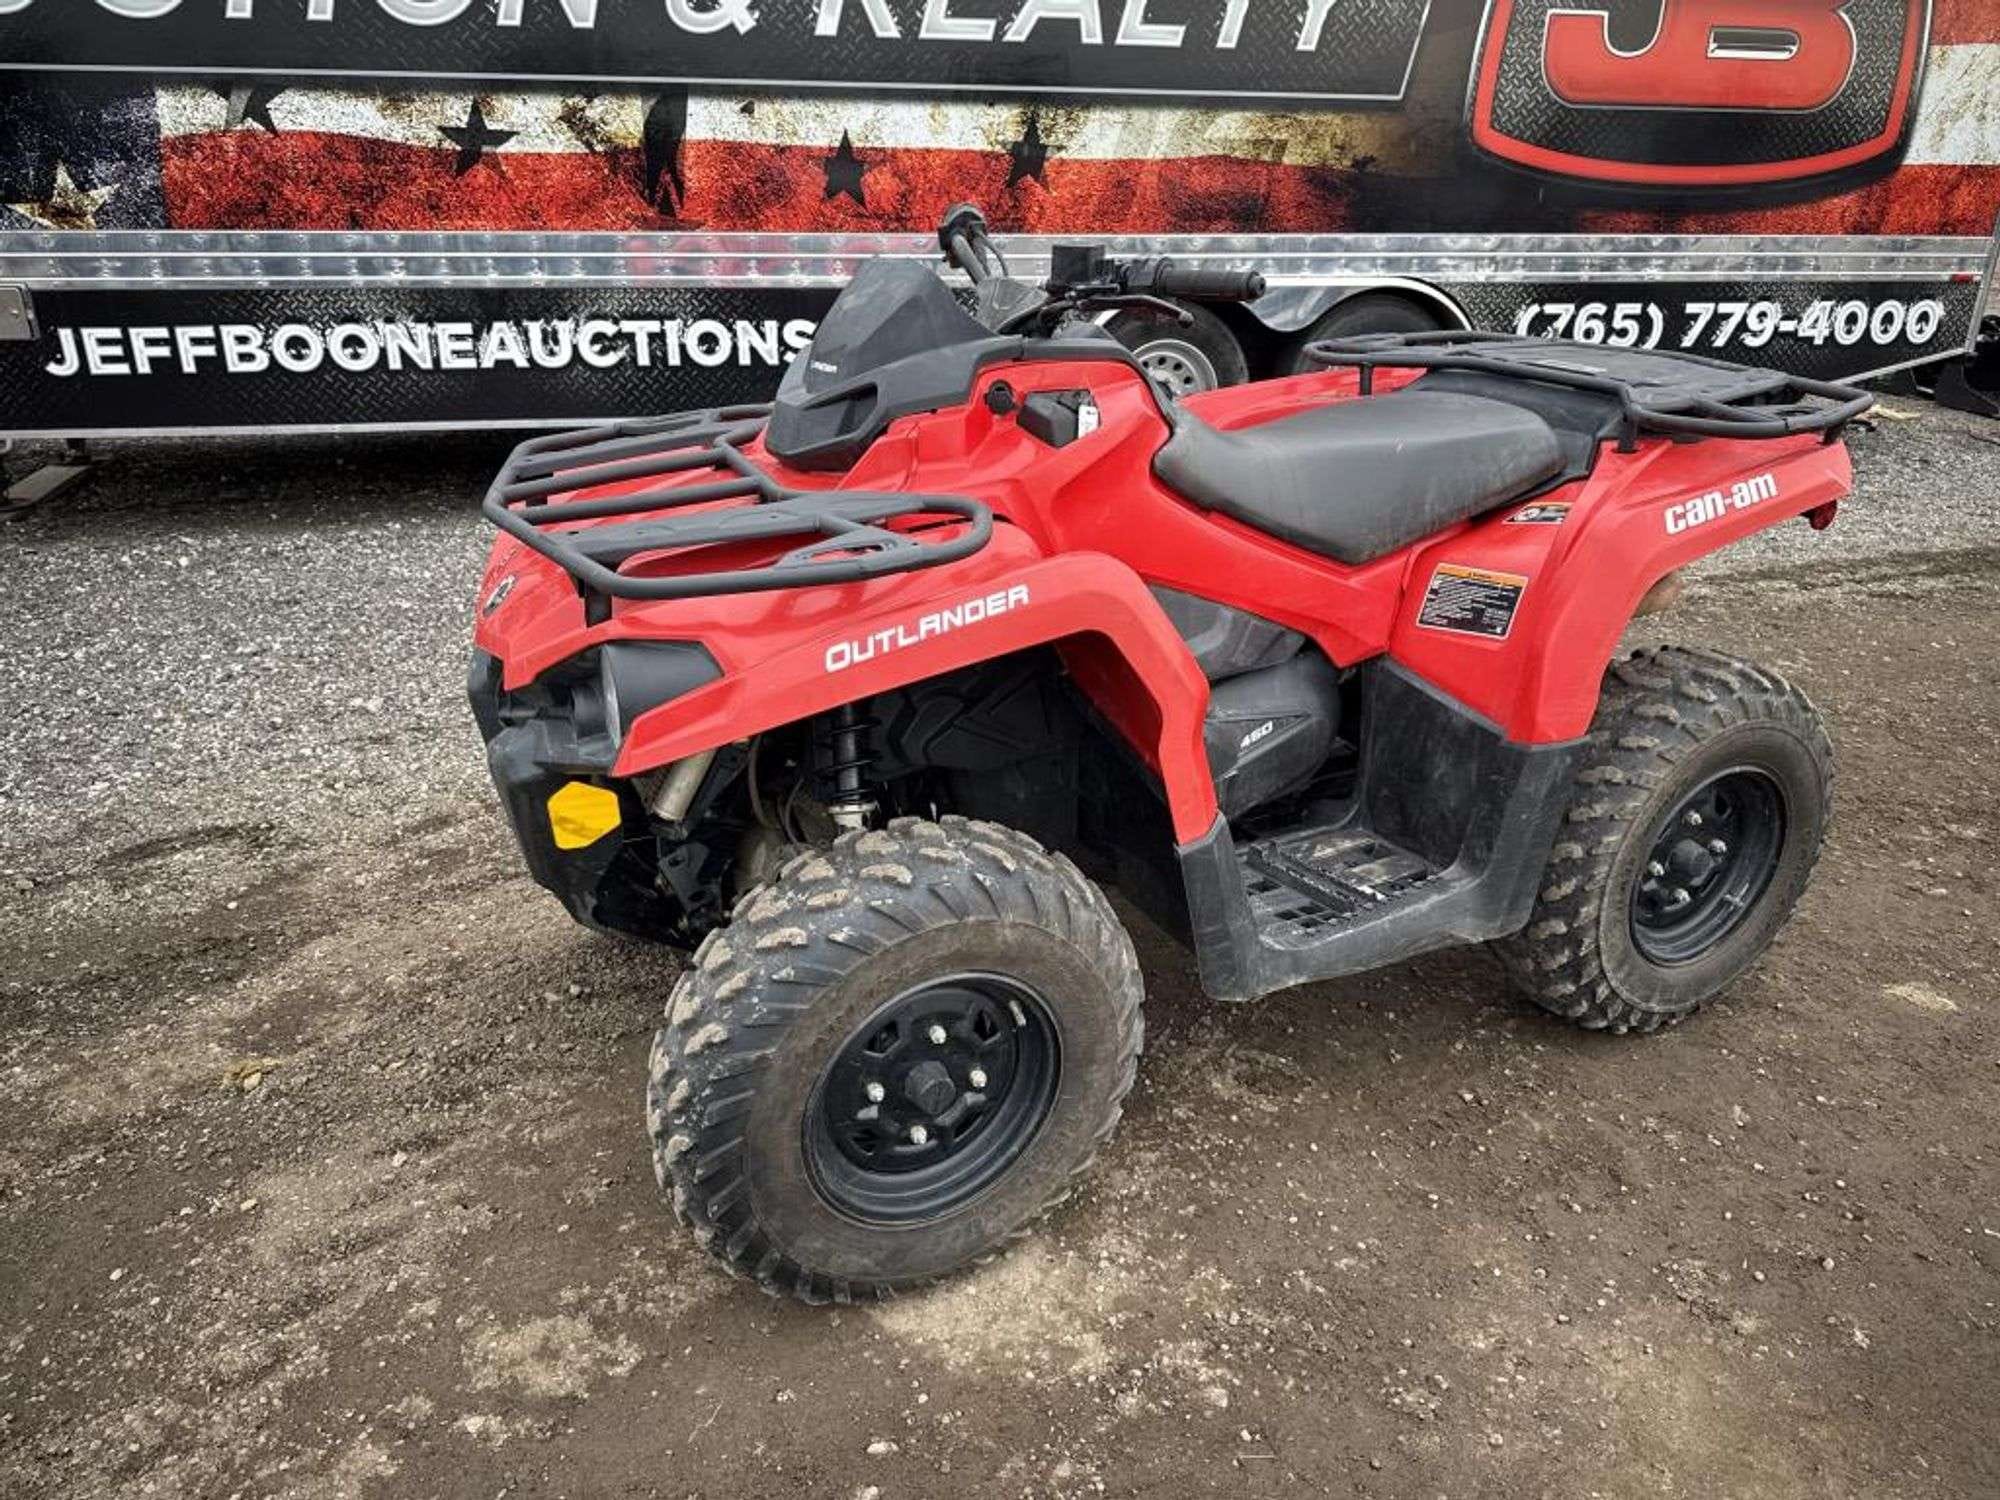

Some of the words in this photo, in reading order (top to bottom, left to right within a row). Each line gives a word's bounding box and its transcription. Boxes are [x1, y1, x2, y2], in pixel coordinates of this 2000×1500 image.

[45, 319, 817, 376] JEFFBOONEAUCTIONS
[1515, 302, 1664, 350] (765)
[1680, 299, 1945, 347] 779-4000
[1664, 472, 1778, 535] can-am
[825, 584, 1030, 673] OUTLANDER
